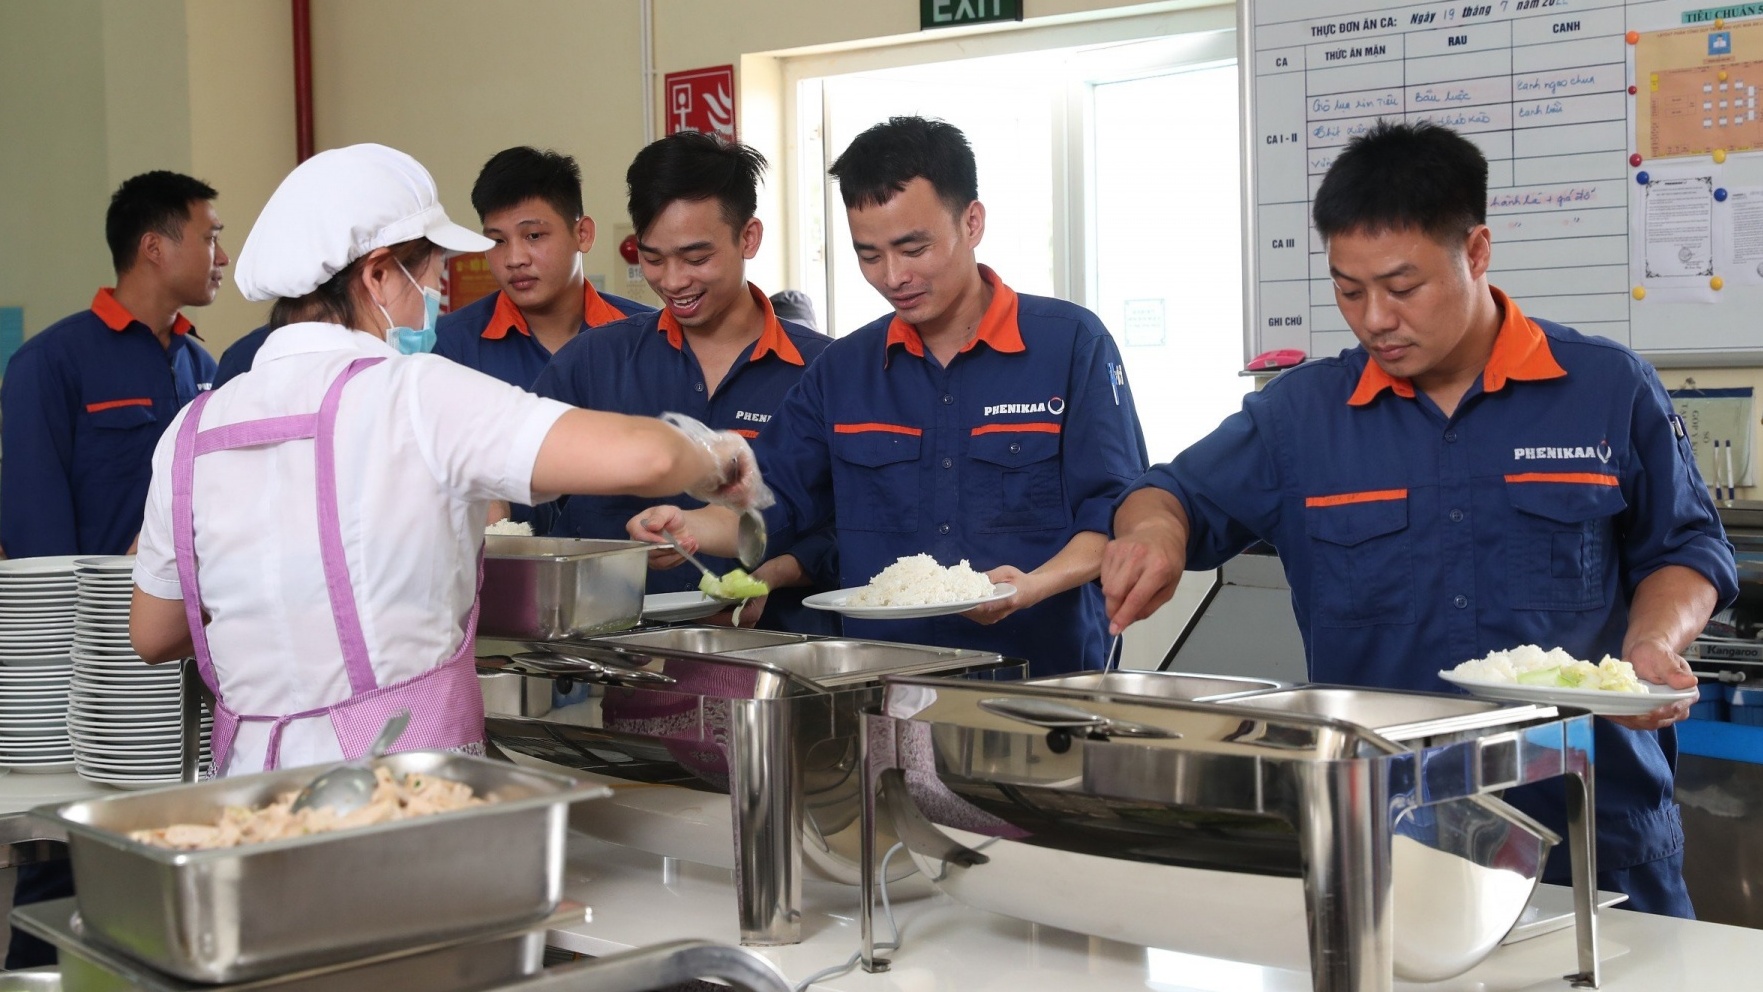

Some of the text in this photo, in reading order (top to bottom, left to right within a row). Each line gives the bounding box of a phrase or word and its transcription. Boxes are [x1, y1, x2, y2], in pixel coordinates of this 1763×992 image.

[1311, 24, 1336, 38] THỰC
[1339, 21, 1360, 33] ĐƠN
[1363, 17, 1377, 30] ĂN
[1380, 16, 1397, 28] CA:
[1410, 11, 1437, 25] Ngày
[1461, 5, 1492, 18] tháng
[1552, 21, 1581, 34] CANH
[1448, 35, 1468, 47] RAU
[1325, 44, 1386, 61] THỨC ĂN MẶN
[1275, 57, 1288, 67] CA
[1266, 134, 1278, 144] CA
[1291, 132, 1298, 143] II
[1272, 238, 1295, 249] CA III
[1268, 314, 1303, 327] GHI CHÚ
[984, 401, 1046, 416] PHENIKAA
[1514, 446, 1596, 460] PHENIKAA
[1707, 645, 1758, 657] Kangaroo
